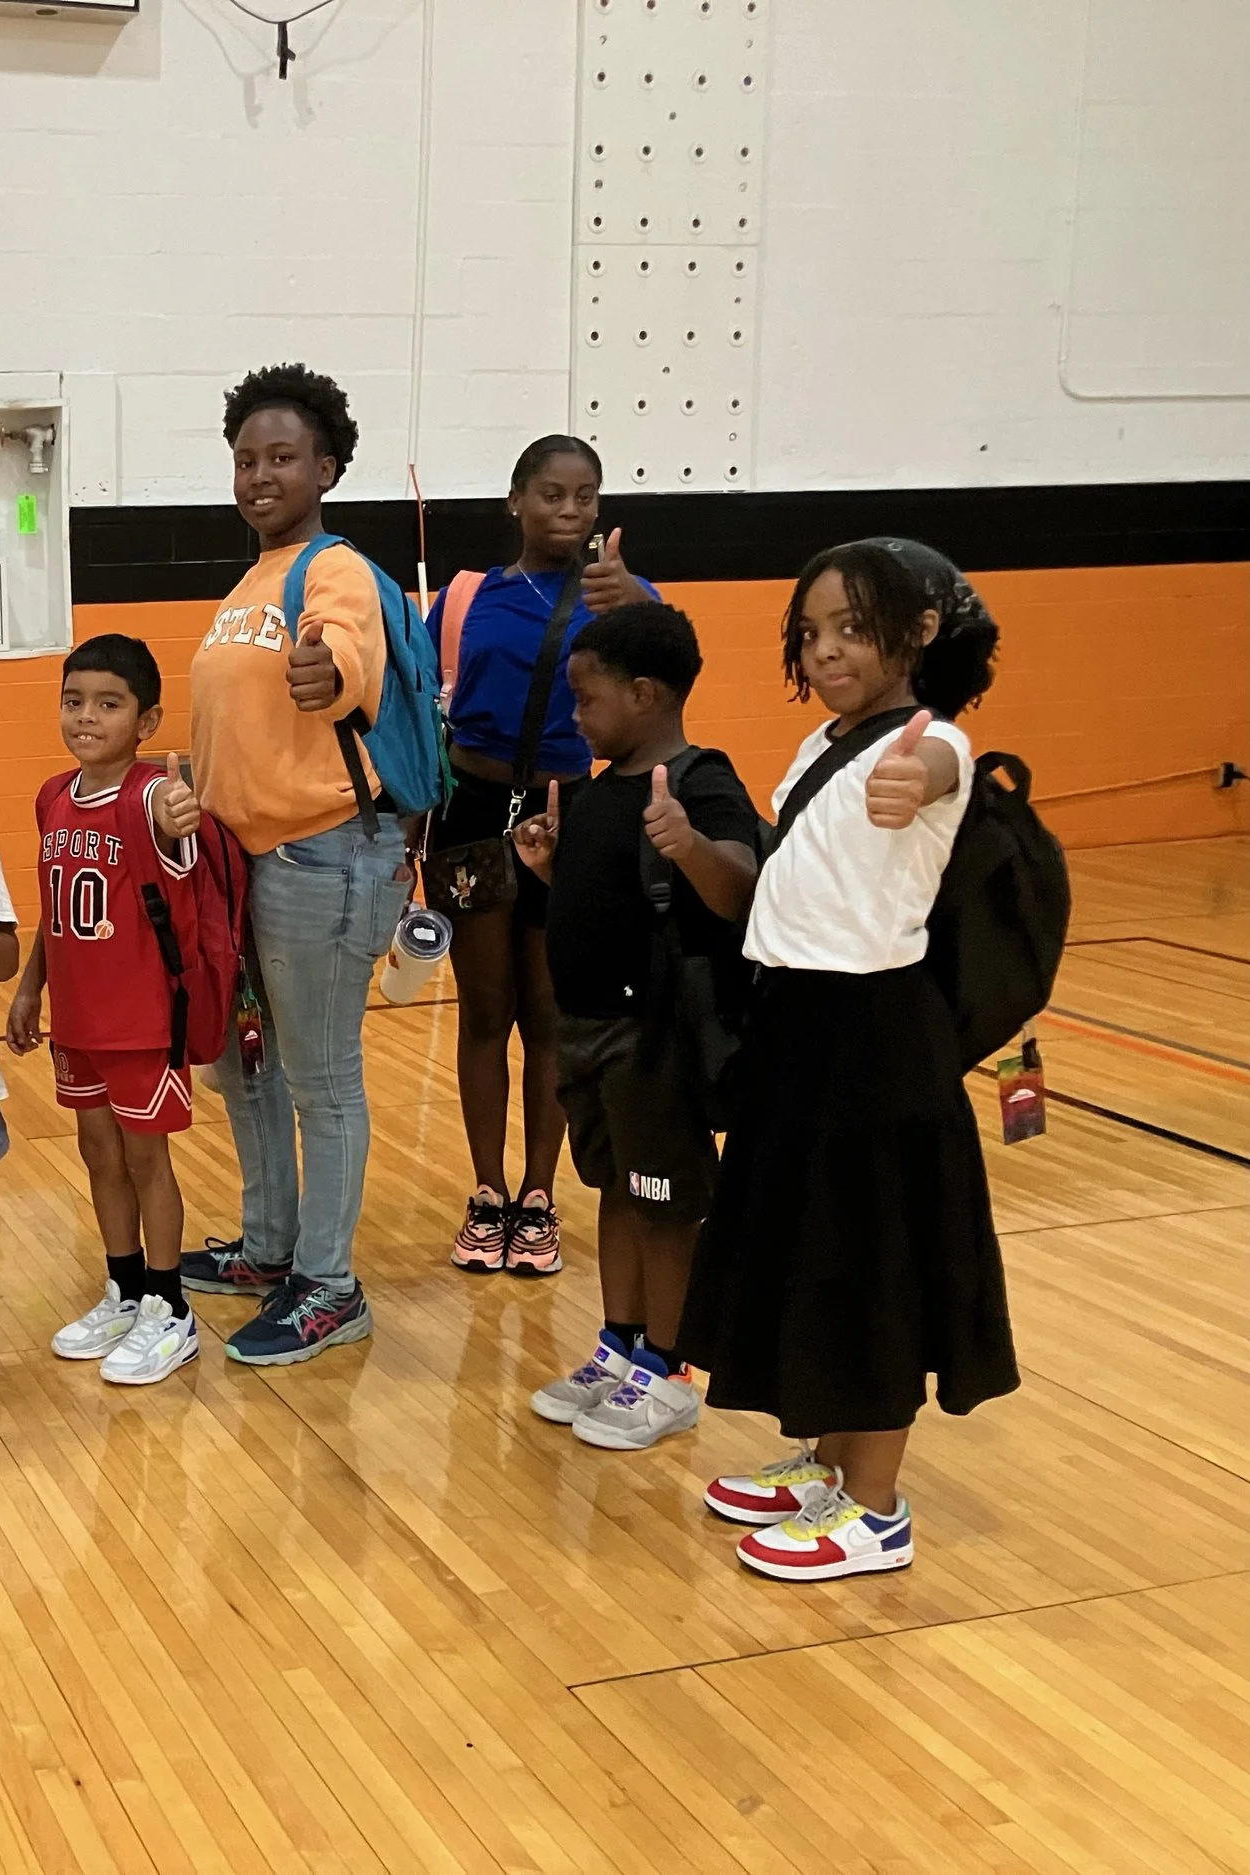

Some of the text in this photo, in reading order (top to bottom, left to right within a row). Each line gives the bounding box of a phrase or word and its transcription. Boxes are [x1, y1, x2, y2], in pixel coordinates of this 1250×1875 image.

[42, 828, 123, 865] SPORT
[49, 864, 108, 941] 10
[640, 1175, 671, 1202] NBA
